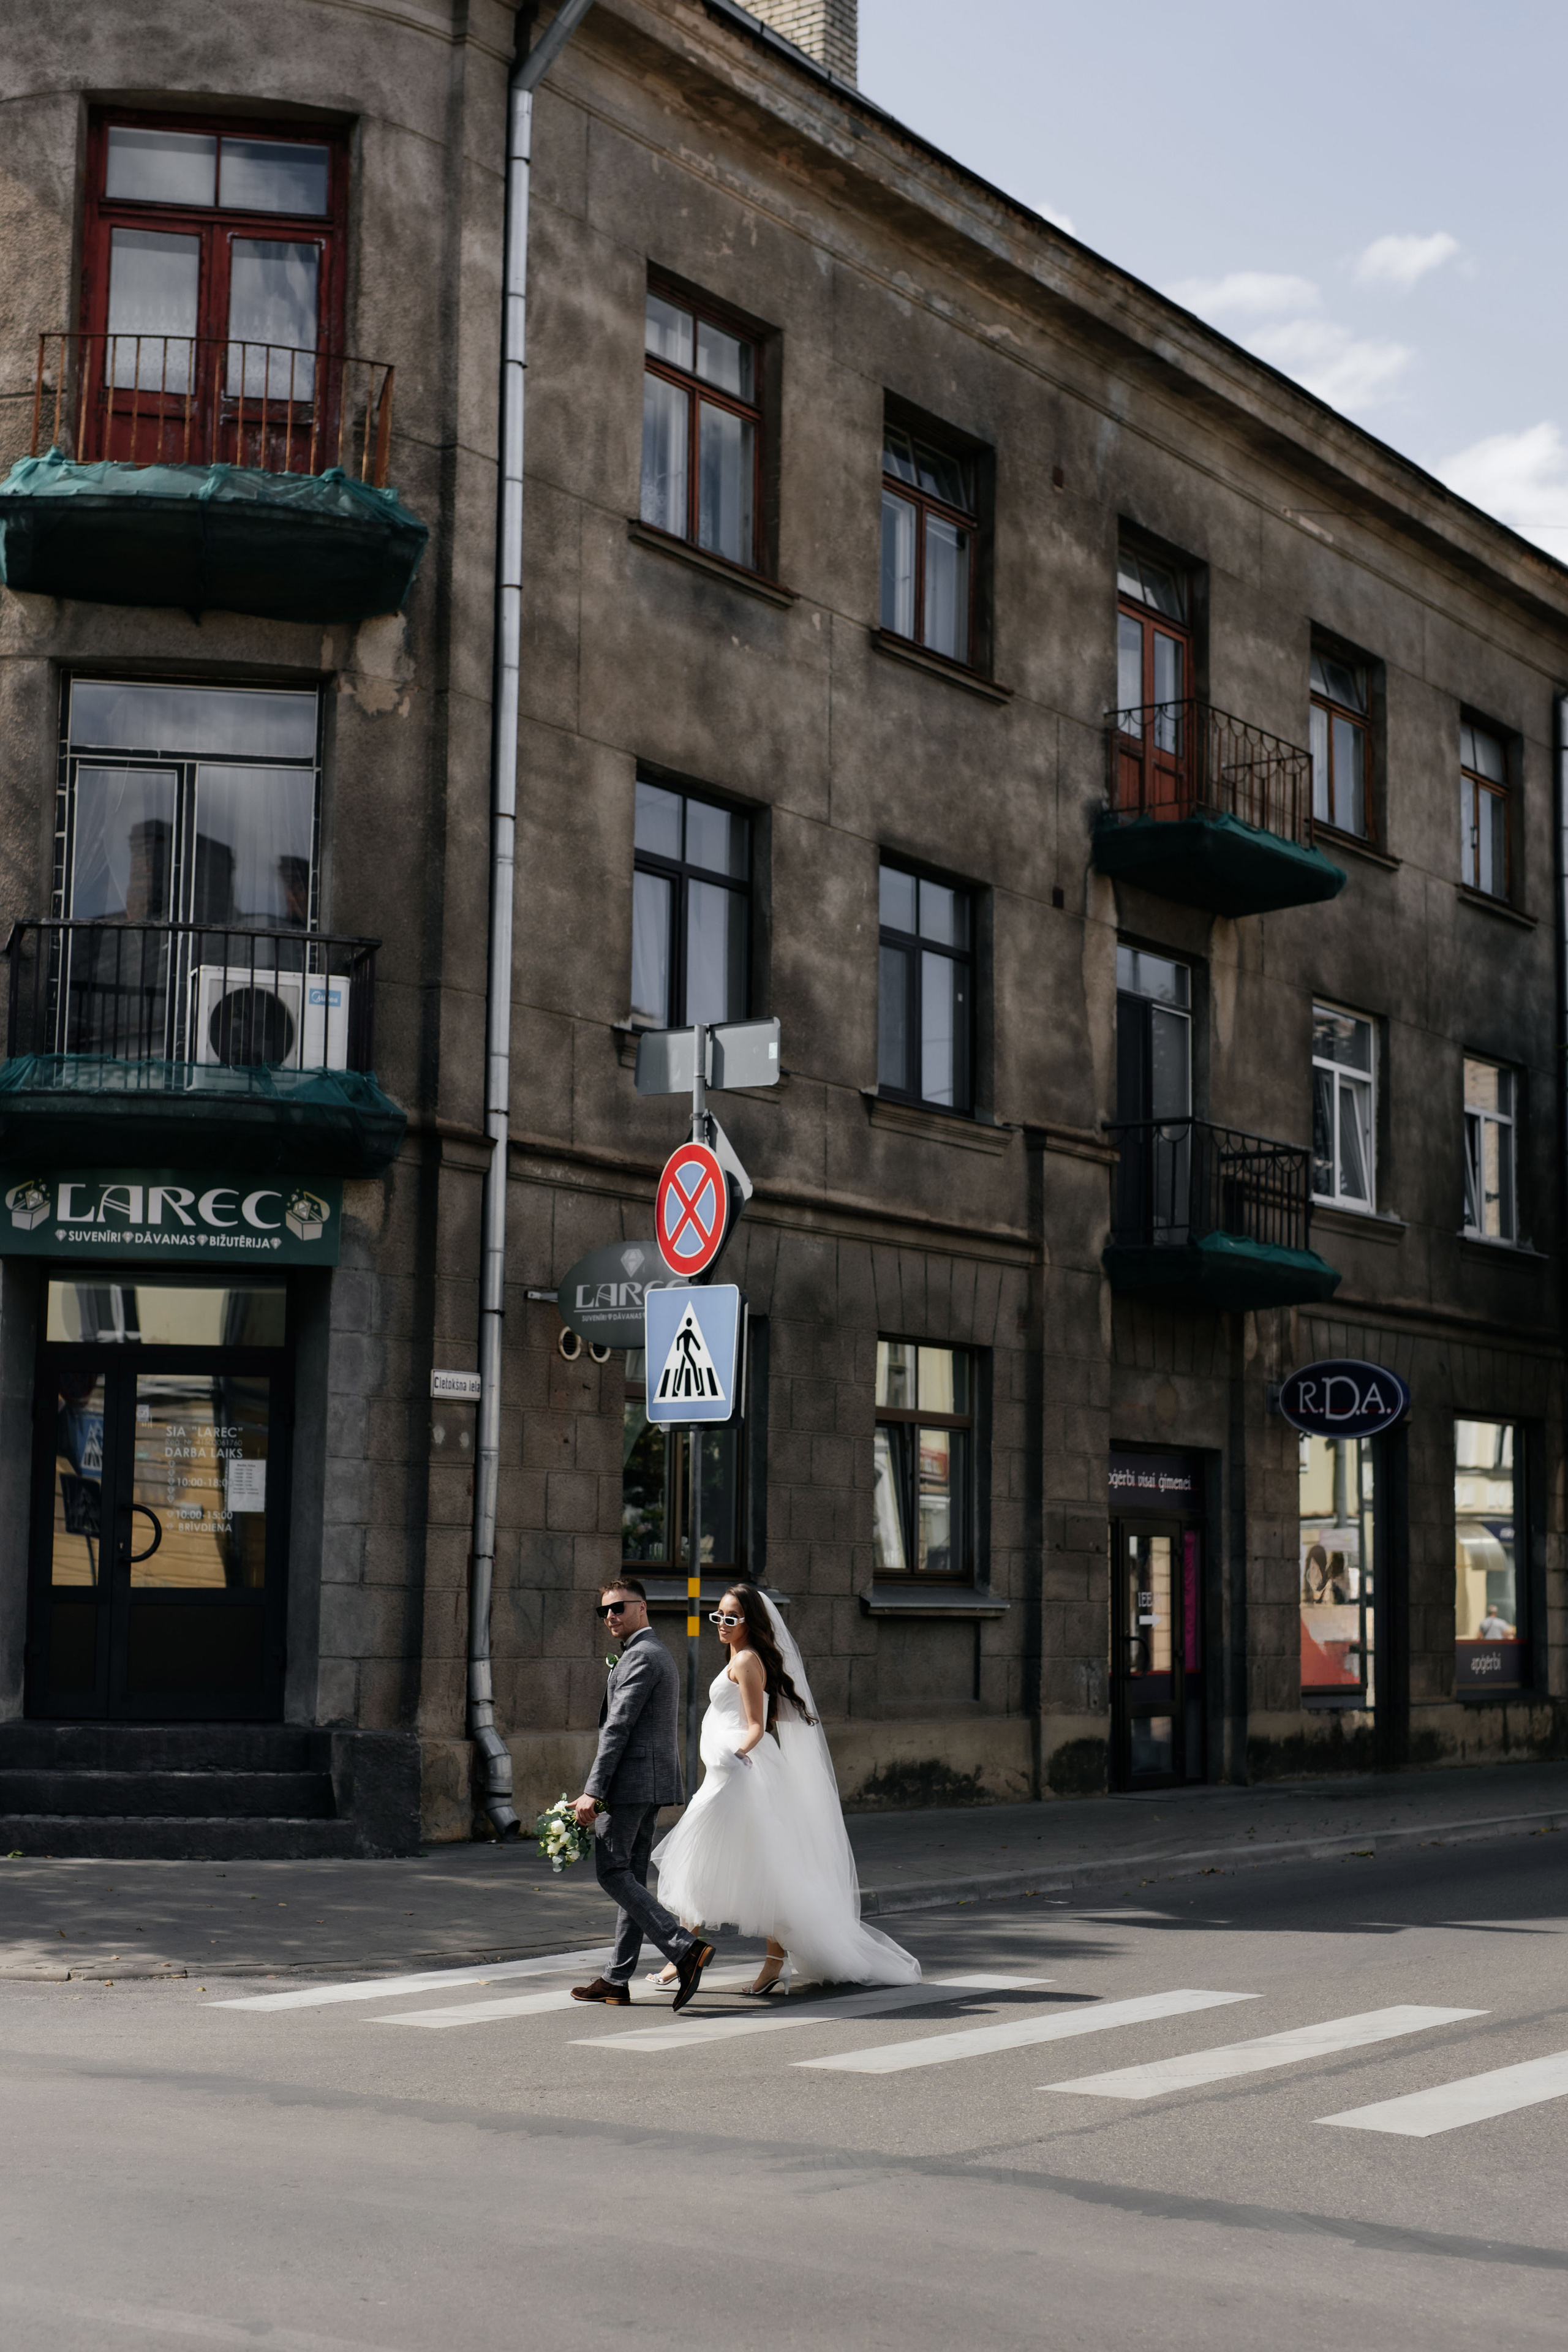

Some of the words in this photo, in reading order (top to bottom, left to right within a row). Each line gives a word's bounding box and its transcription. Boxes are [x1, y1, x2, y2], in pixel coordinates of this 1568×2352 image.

[314, 992, 338, 1003] Miea
[57, 1183, 282, 1229] LAREC
[69, 1229, 121, 1243] SUVENĪRI
[135, 1232, 195, 1245] DĀVANAS
[209, 1232, 270, 1249] BIŽUTĒRIJA
[613, 1312, 642, 1321] DĀVANAS
[166, 1427, 186, 1437] SIA
[192, 1427, 243, 1438] "LAREC"
[165, 1447, 206, 1457] DARBA
[210, 1448, 243, 1458] LAIKS
[176, 1510, 233, 1520] 10:00-15:00
[178, 1521, 233, 1532] BRĪVDIENA
